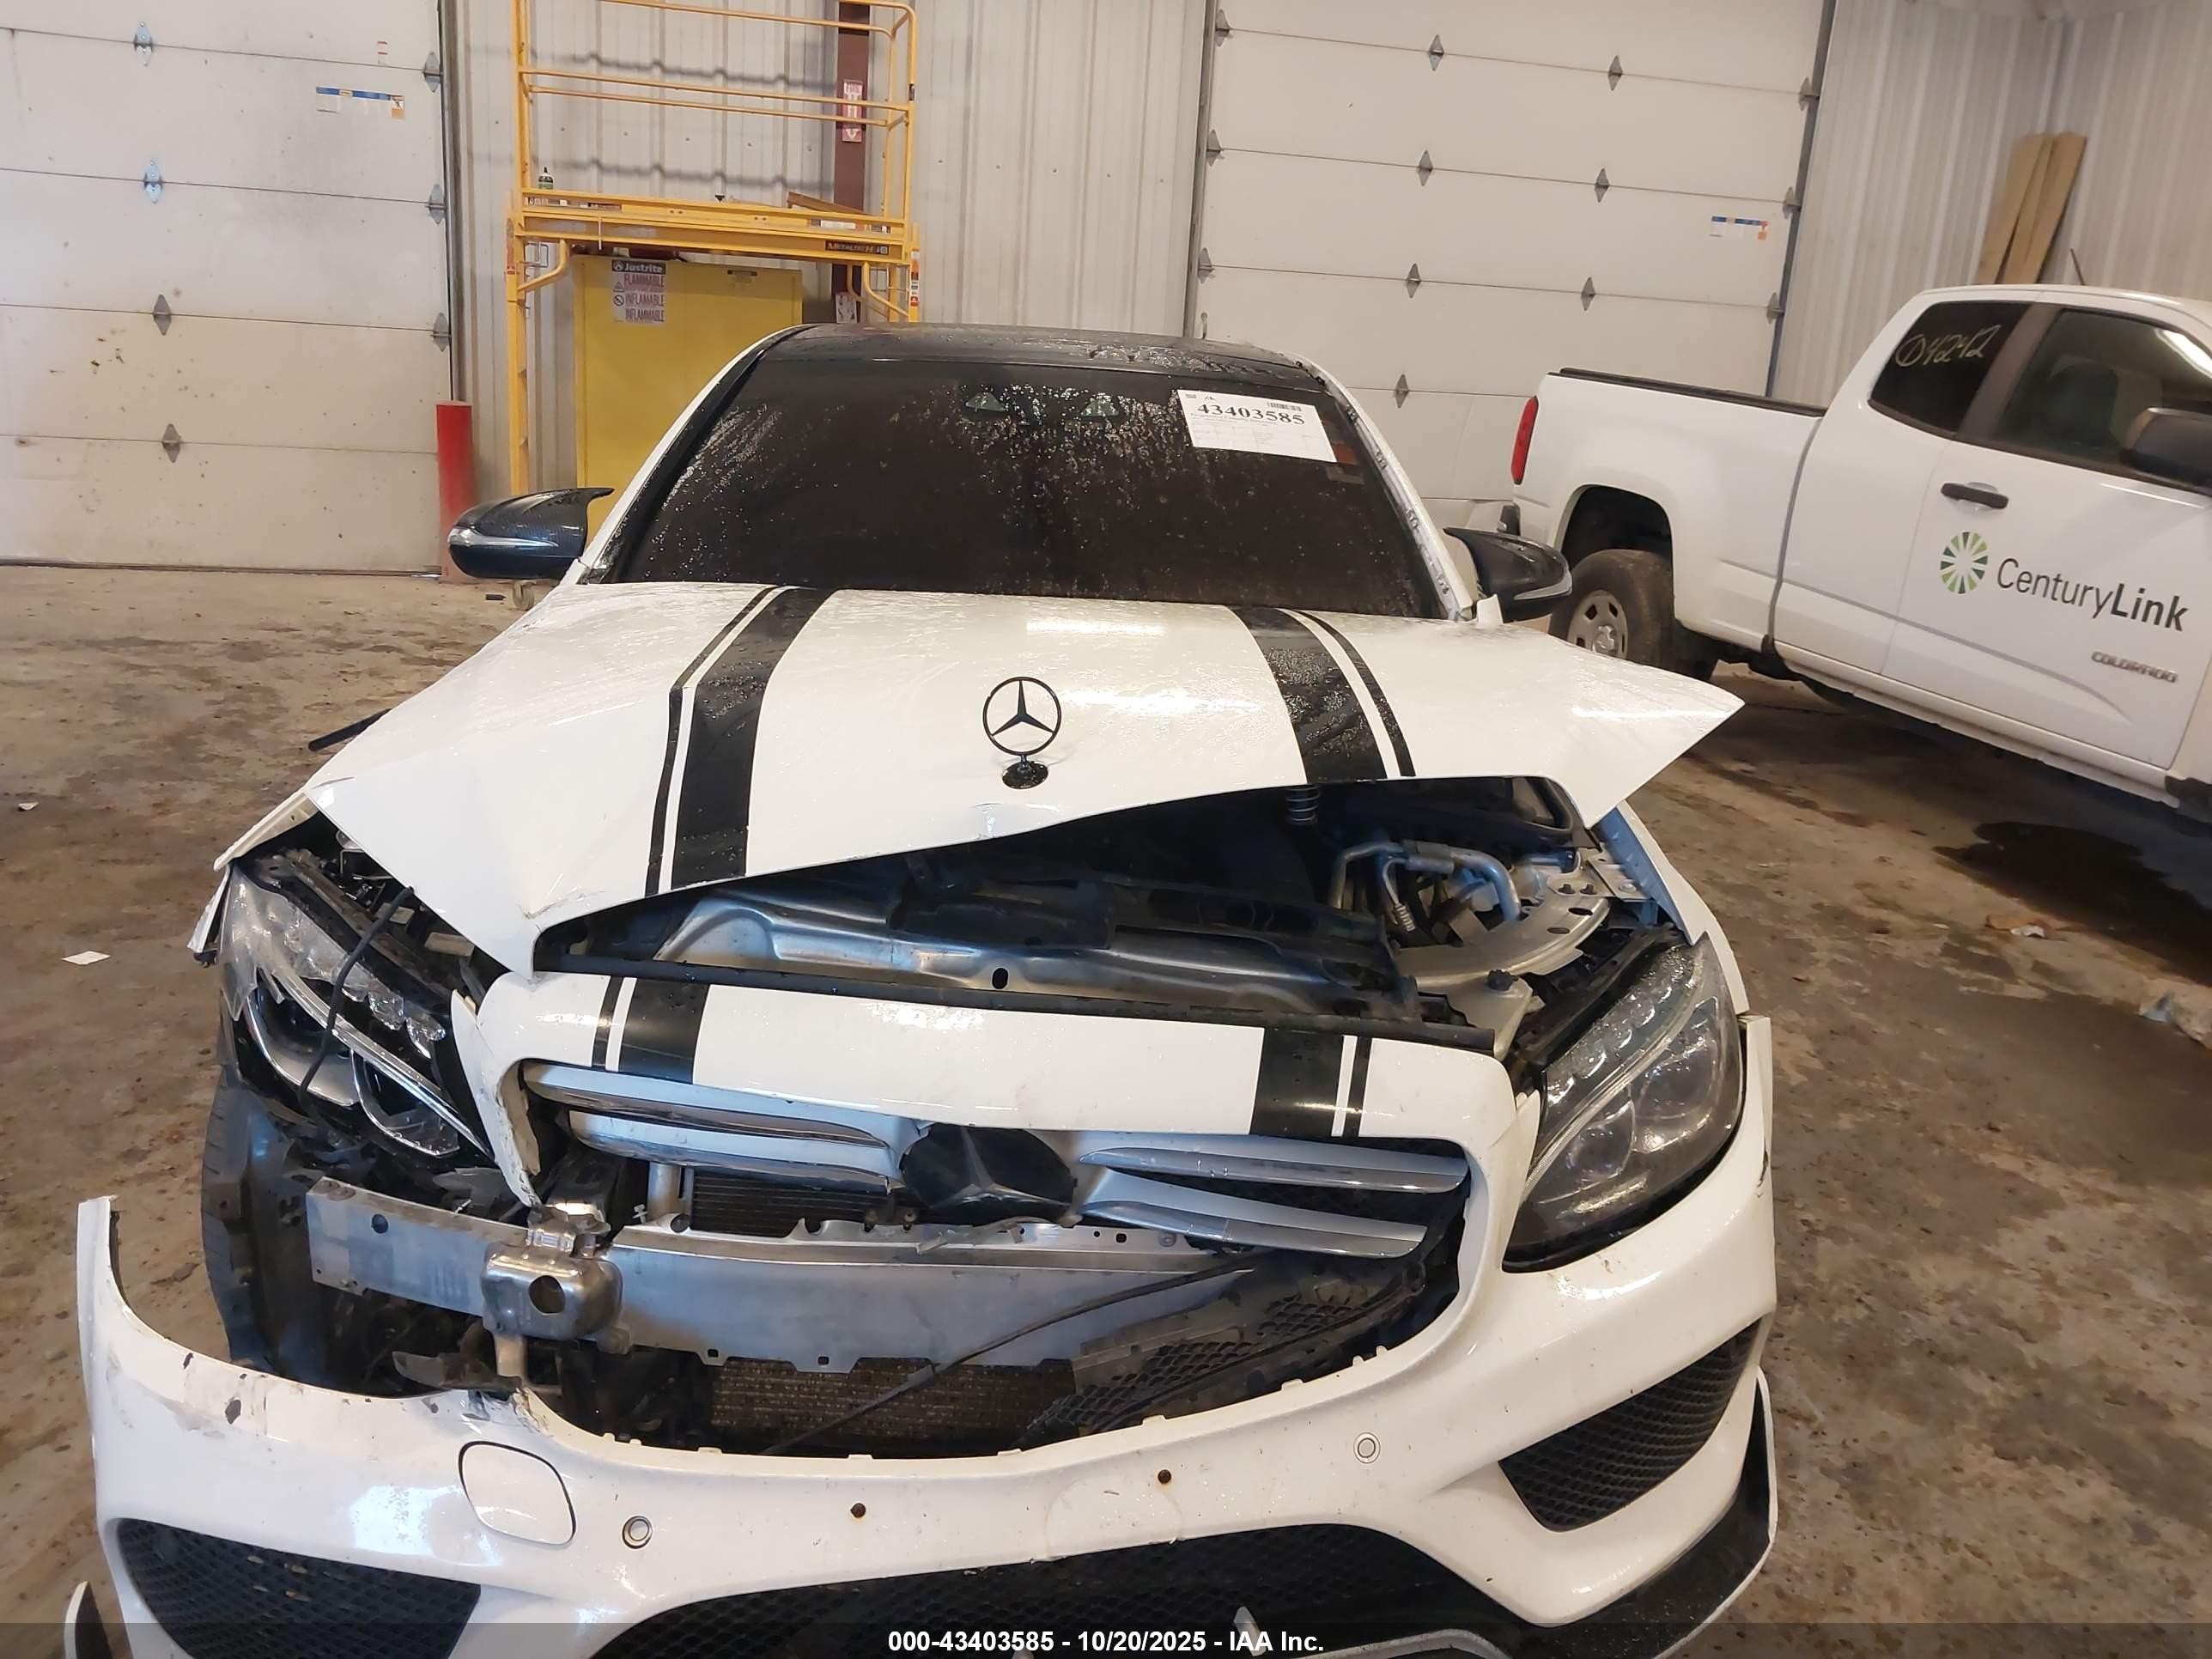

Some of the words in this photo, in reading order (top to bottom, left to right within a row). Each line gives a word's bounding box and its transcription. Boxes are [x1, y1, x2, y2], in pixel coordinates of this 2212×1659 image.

[624, 262, 663, 273] Justrite
[1197, 404, 1305, 425] 43403585
[1996, 557, 2189, 632] CenturyLink
[2091, 651, 2178, 684] COLORADO
